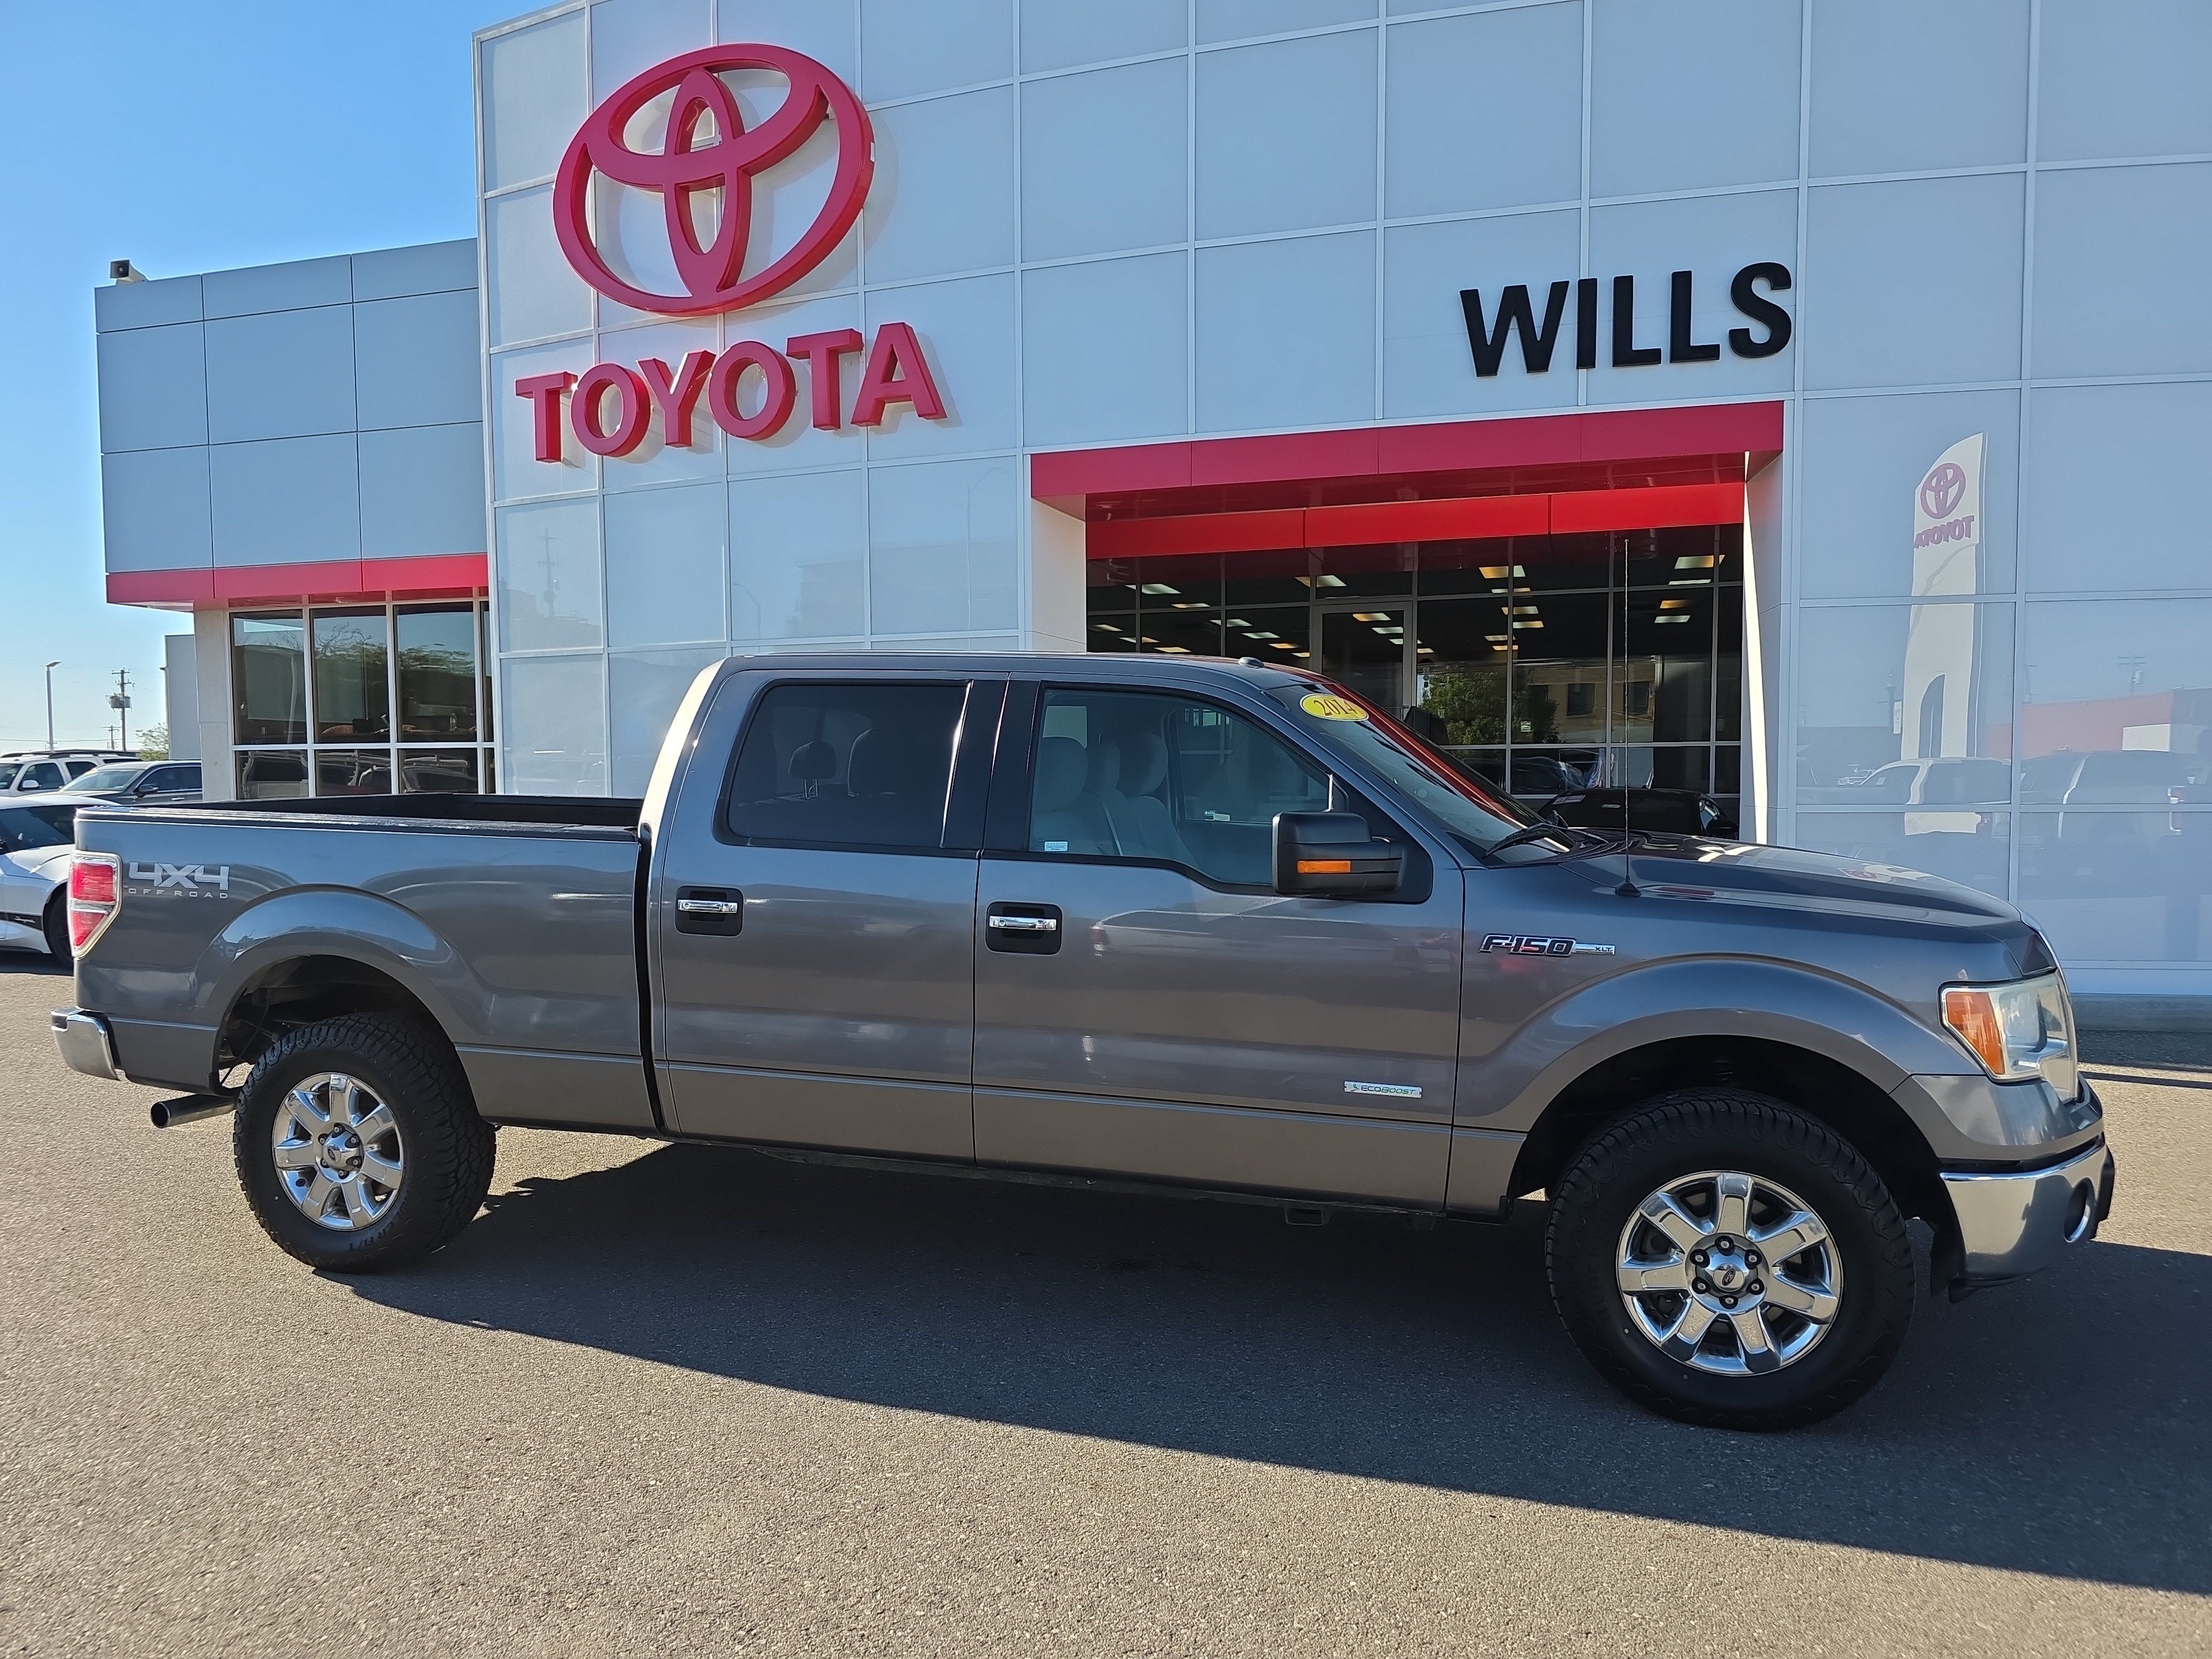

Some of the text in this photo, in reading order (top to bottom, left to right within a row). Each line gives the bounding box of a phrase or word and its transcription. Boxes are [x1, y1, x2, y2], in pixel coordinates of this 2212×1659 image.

[1459, 262, 1792, 377] WILLS
[515, 322, 948, 463] TOYOTA
[1313, 699, 1358, 716] 2014
[1478, 934, 1576, 956] F-150
